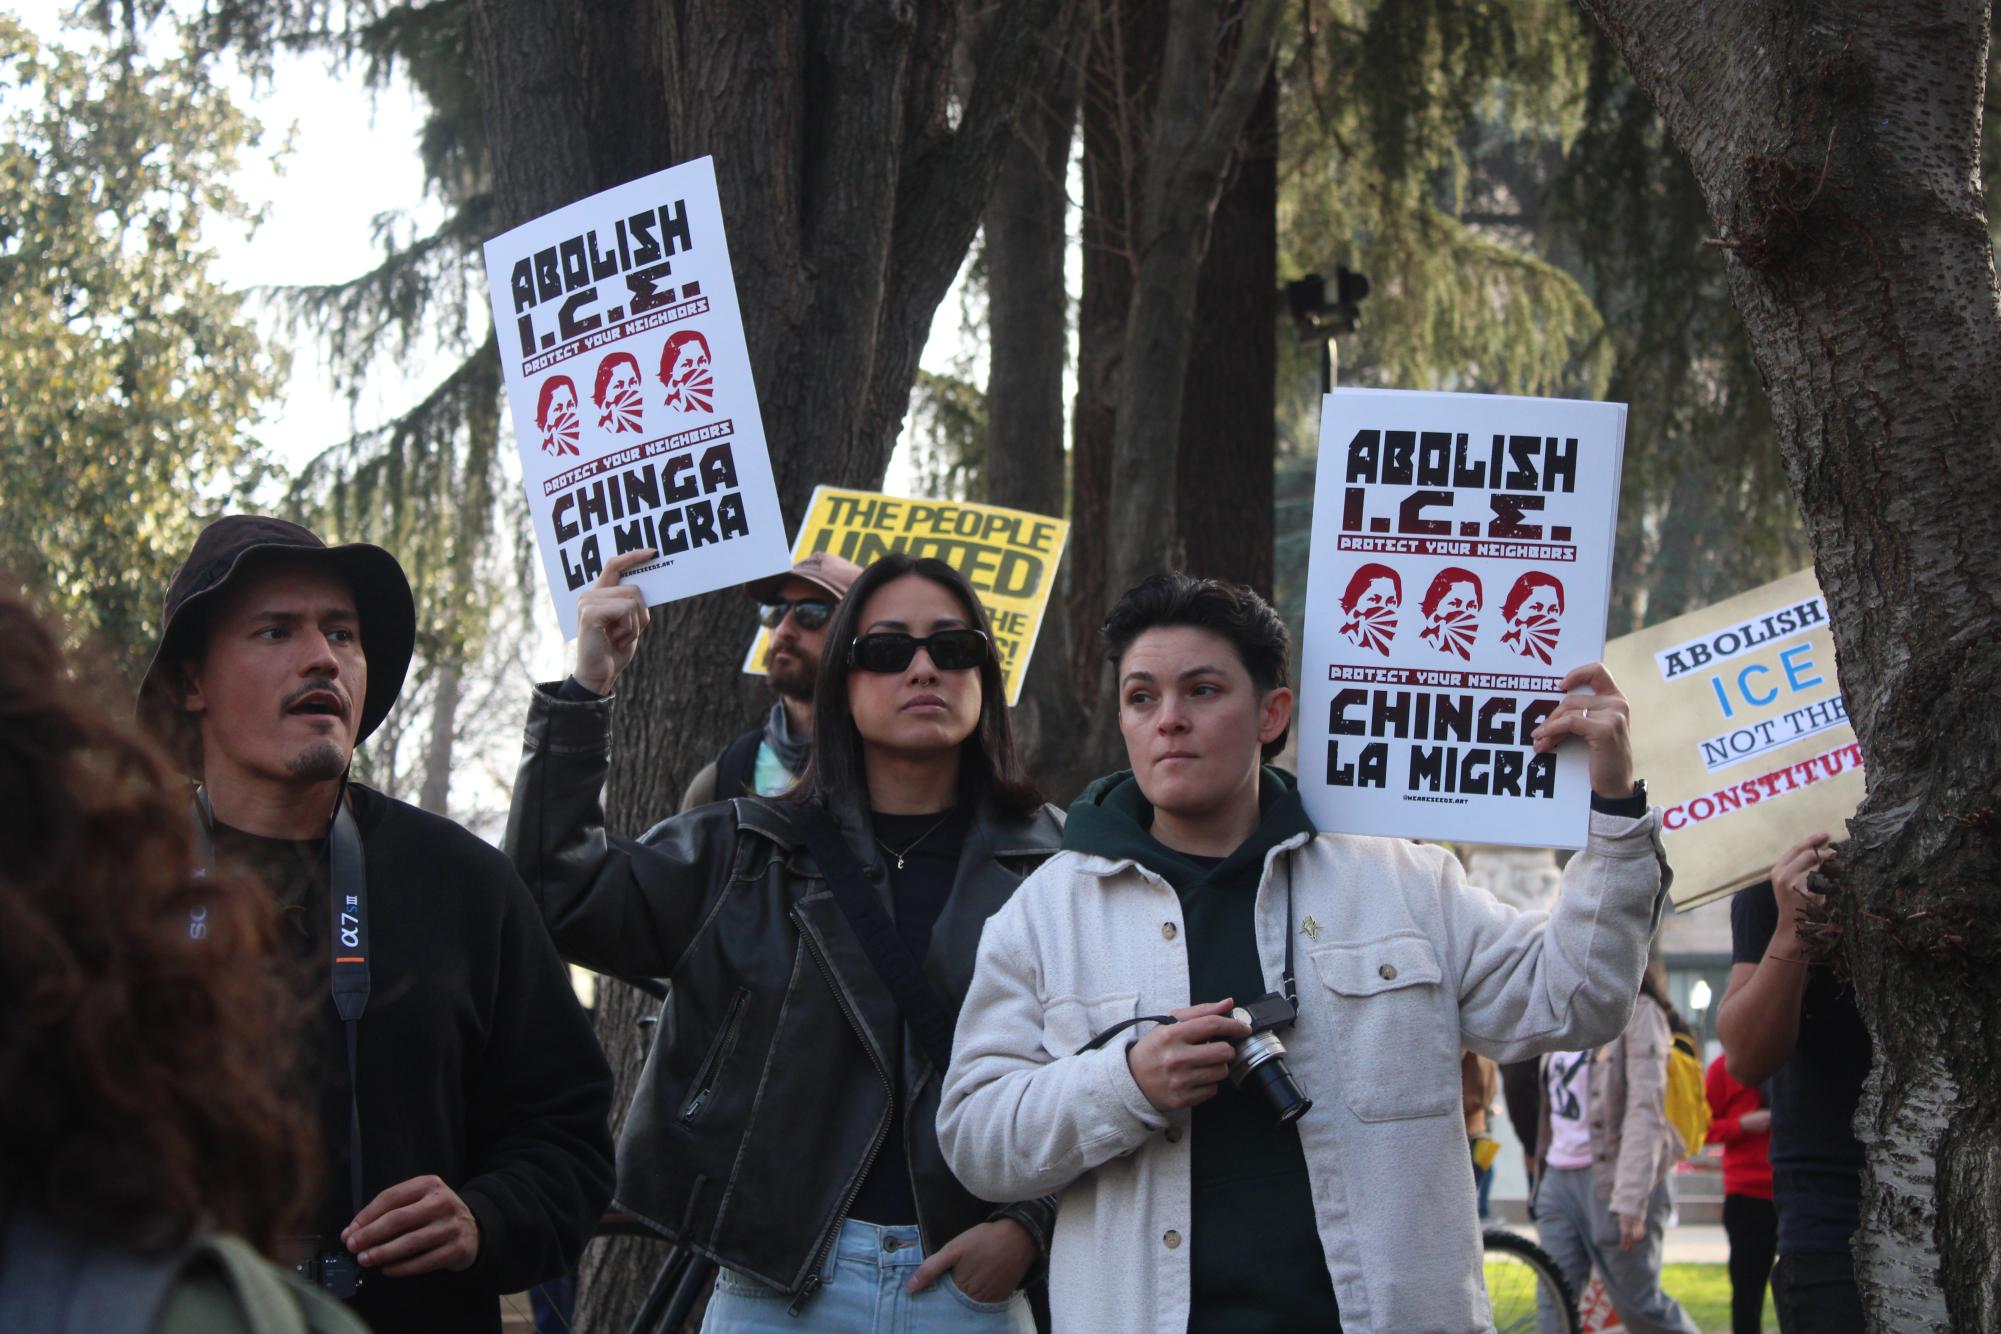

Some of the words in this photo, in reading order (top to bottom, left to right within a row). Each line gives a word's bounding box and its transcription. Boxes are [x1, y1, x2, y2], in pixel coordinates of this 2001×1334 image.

[510, 199, 693, 314] ABOLISH
[525, 343, 580, 376] PROTECT
[585, 330, 621, 351] YOUR
[625, 300, 709, 335] NEIGHBORS
[544, 461, 600, 494] PROTECT
[602, 451, 646, 470] YOUR
[646, 422, 732, 456] NEIGHBORS
[1346, 429, 1578, 493] ABOLISH
[551, 442, 739, 545] CHINGA
[827, 496, 902, 532] THE
[903, 505, 1057, 554] PEOPLE
[559, 534, 603, 592] LA
[613, 492, 750, 560] MIGRA
[1340, 536, 1419, 553] PROTECT
[1425, 540, 1471, 555] YOUR
[1477, 543, 1575, 561] NEIGHBORS
[983, 607, 1028, 636] HE
[1664, 599, 1825, 679] ABOLISH
[1330, 666, 1410, 684] PROTECT
[1416, 671, 1462, 687] YOUR
[1468, 674, 1563, 692] NEIGHBORS
[1712, 643, 1824, 718] ICE
[1700, 721, 1778, 765] NOT
[1784, 698, 1848, 736] THE
[1326, 740, 1389, 789] LA
[1408, 744, 1557, 799] MIGRA
